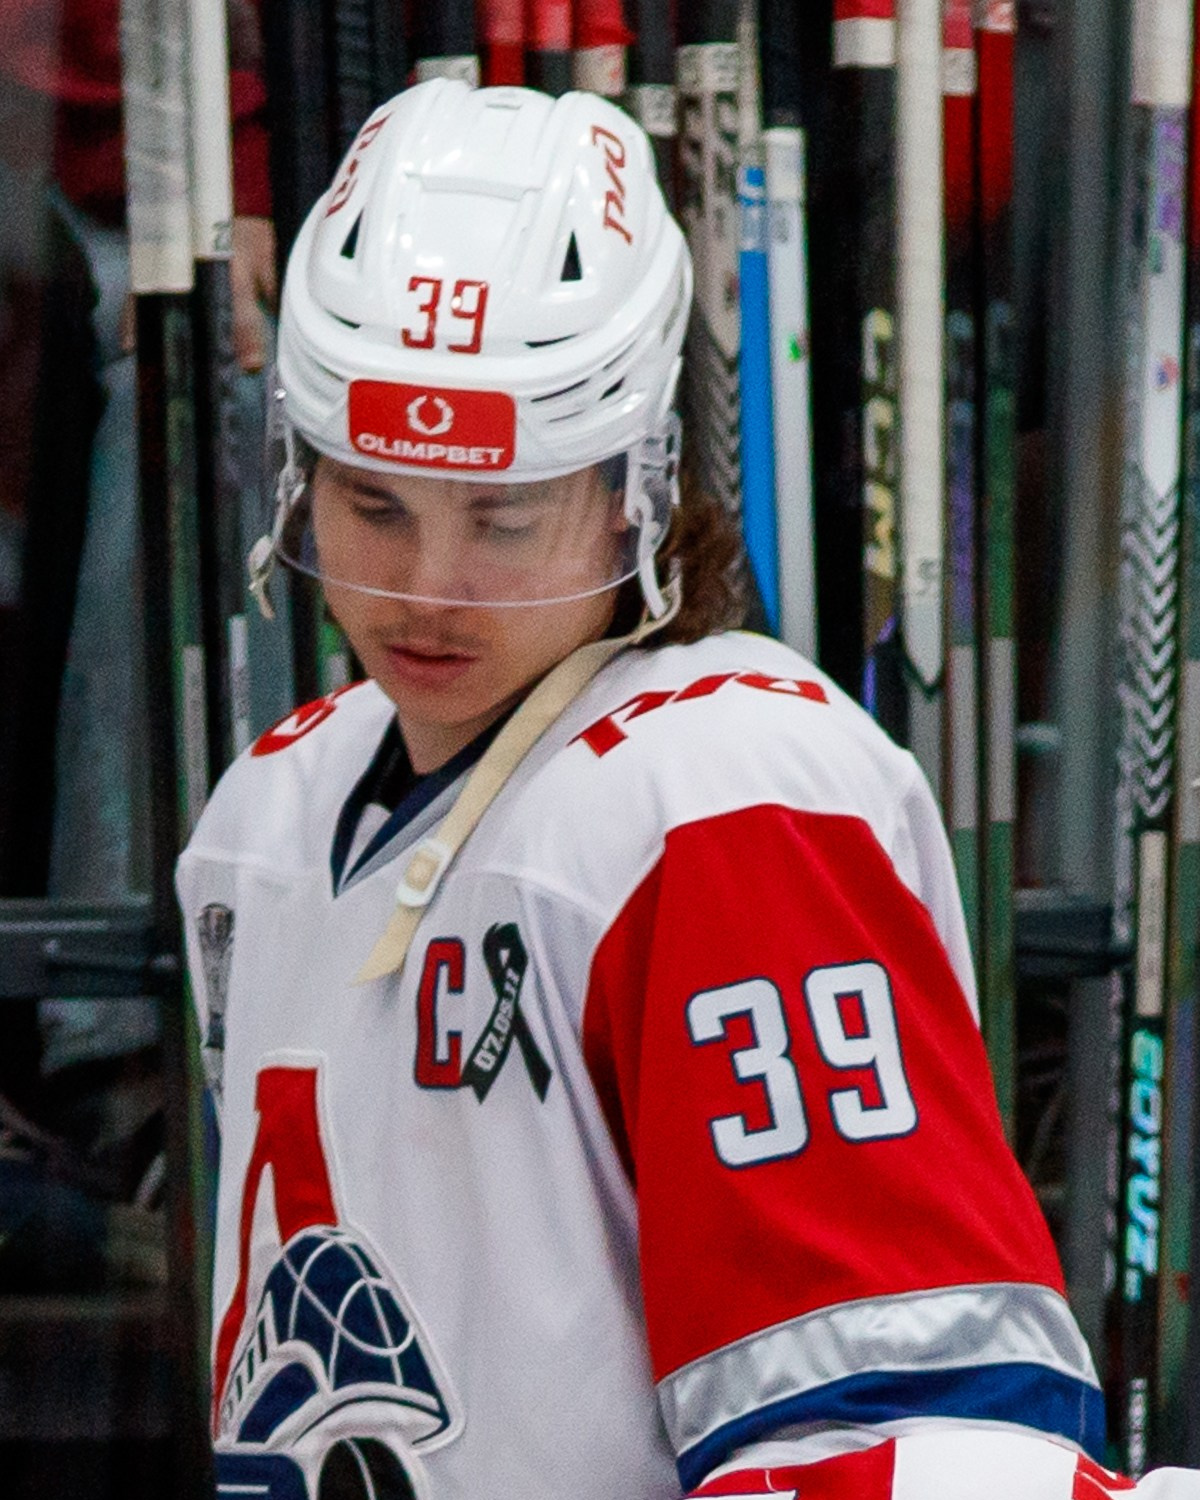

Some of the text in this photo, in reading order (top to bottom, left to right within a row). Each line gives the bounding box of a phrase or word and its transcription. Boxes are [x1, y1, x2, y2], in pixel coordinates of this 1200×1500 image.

[400, 275, 490, 355] 39
[355, 430, 506, 467] OLIMPBET
[413, 936, 465, 1089] C
[685, 959, 919, 1171] 39
